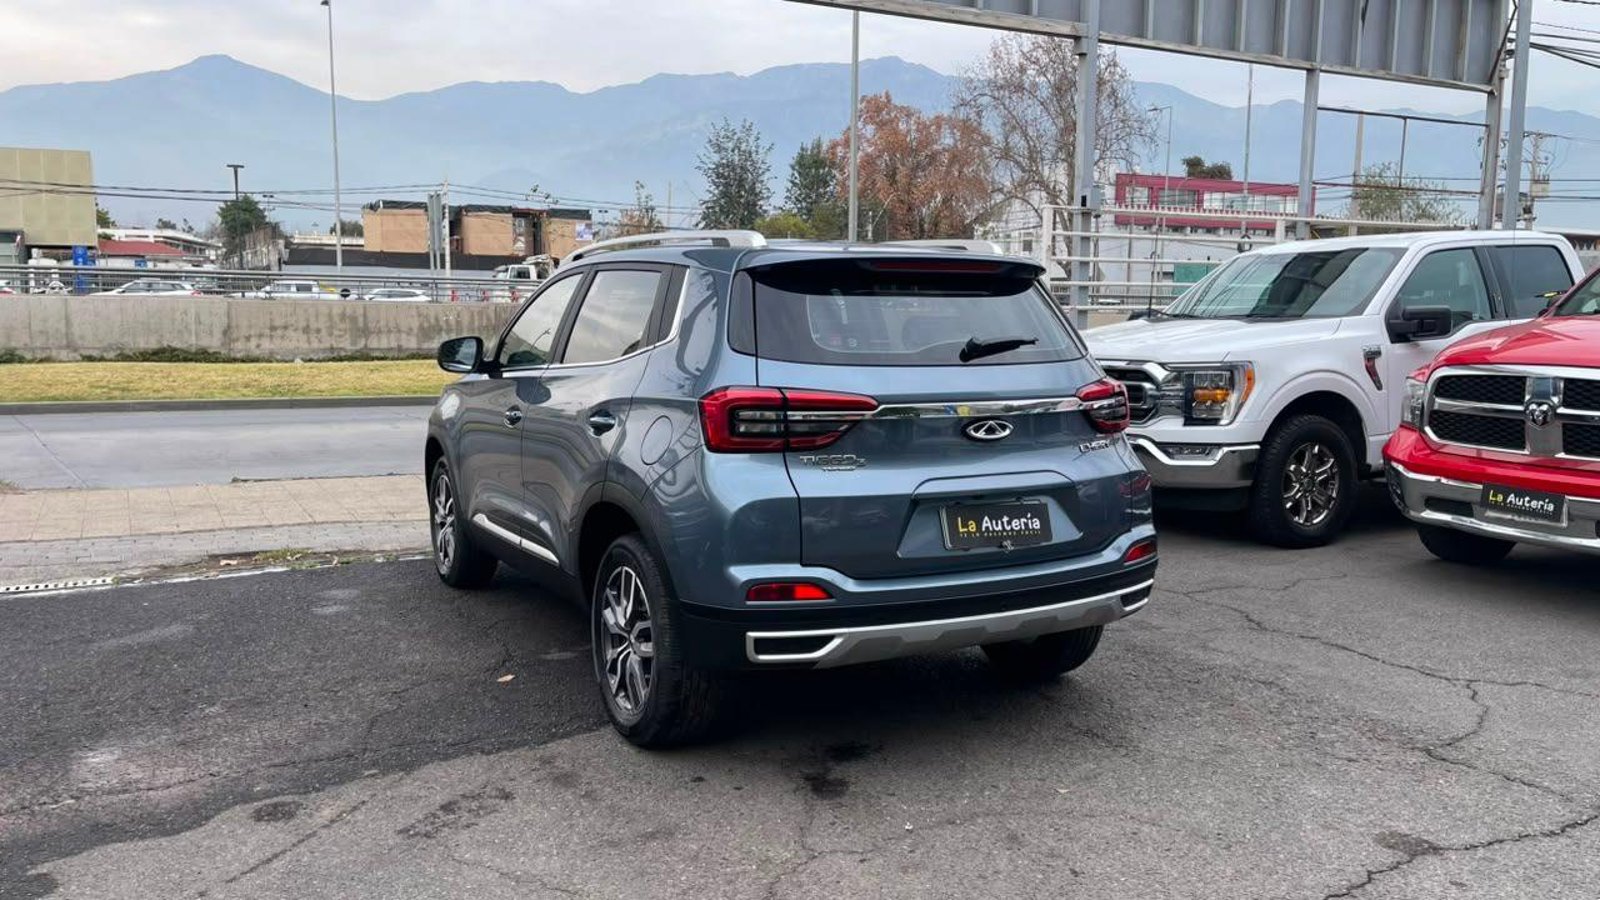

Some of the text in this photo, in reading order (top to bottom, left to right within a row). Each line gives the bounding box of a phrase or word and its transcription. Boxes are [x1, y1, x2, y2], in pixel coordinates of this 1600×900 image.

[1488, 489, 1504, 502] La
[1506, 493, 1555, 512] Autería
[957, 512, 1041, 533] La Autería
